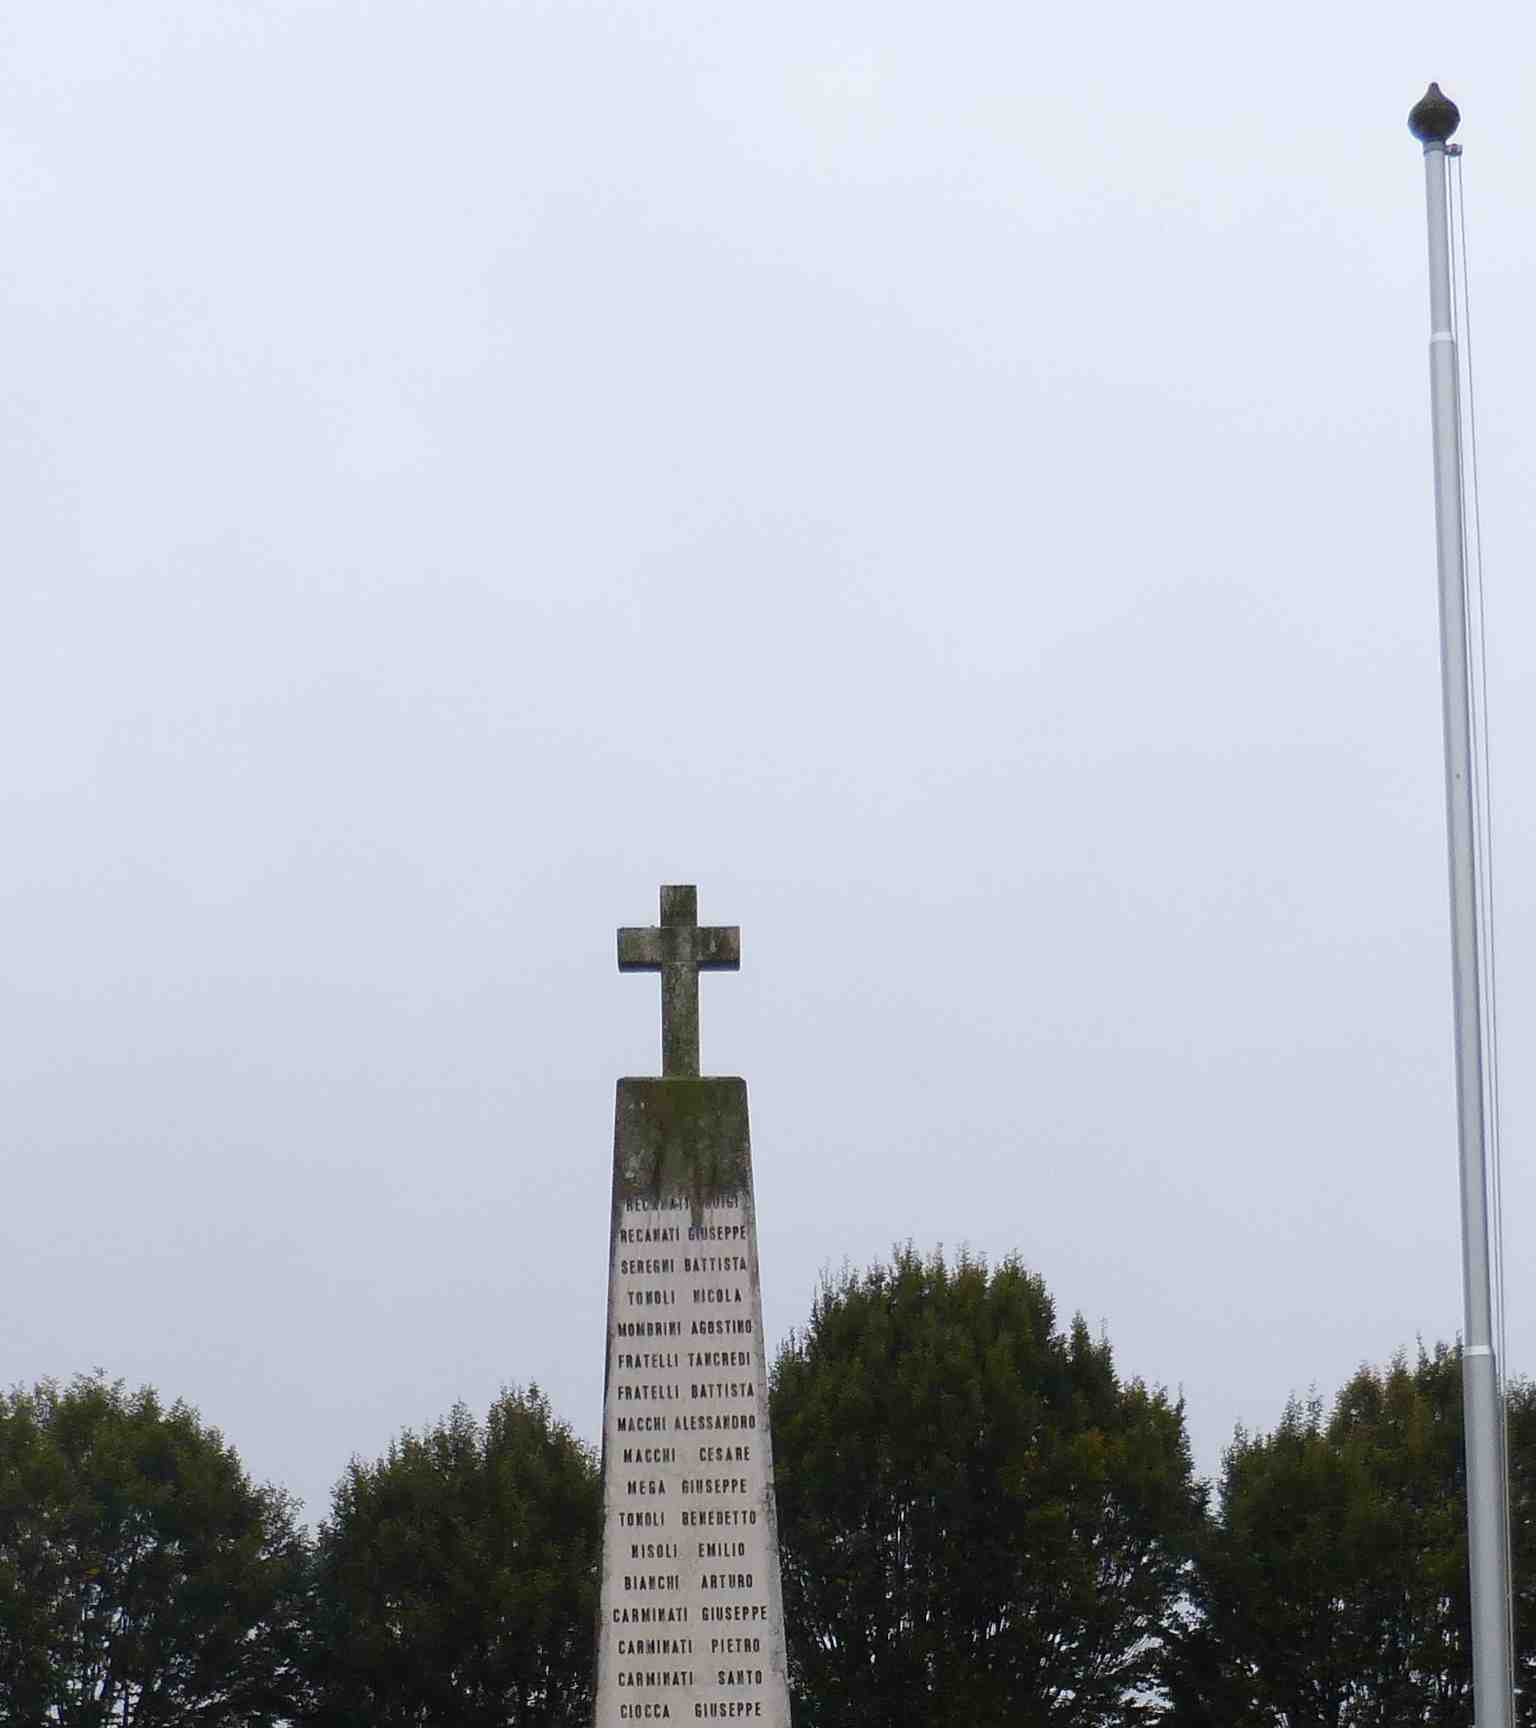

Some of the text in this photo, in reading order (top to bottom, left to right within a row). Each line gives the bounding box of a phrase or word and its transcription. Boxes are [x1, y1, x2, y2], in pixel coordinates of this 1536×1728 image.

[620, 1225, 746, 1243] RECANATI GIUSEPPE
[621, 1257, 747, 1275] SEREGNI BATTISTA
[628, 1289, 742, 1305] TONOLI NICOLA
[691, 1320, 752, 1335] AGOSTINO
[619, 1352, 750, 1369] FRATELLI TANCREDI
[618, 1383, 754, 1400] FRATELLI BATTISTA
[617, 1415, 755, 1432] MACCHI ALESSANDRO
[624, 1446, 750, 1463] MACCHI CESARE
[627, 1479, 747, 1495] MEGA GIUSEPPE
[620, 1511, 756, 1527] TONOLI BENEDETTO
[632, 1543, 745, 1558] NISOLI EMILIO
[624, 1574, 752, 1590] BIANCHI ARTURO
[613, 1605, 767, 1622] CARMINATI GIUSEPPE
[618, 1638, 760, 1654] CARMINATI PIETRO
[618, 1670, 762, 1686] CARMINATI SANTO
[620, 1702, 761, 1719] CIOCCA GIUSEPPE
